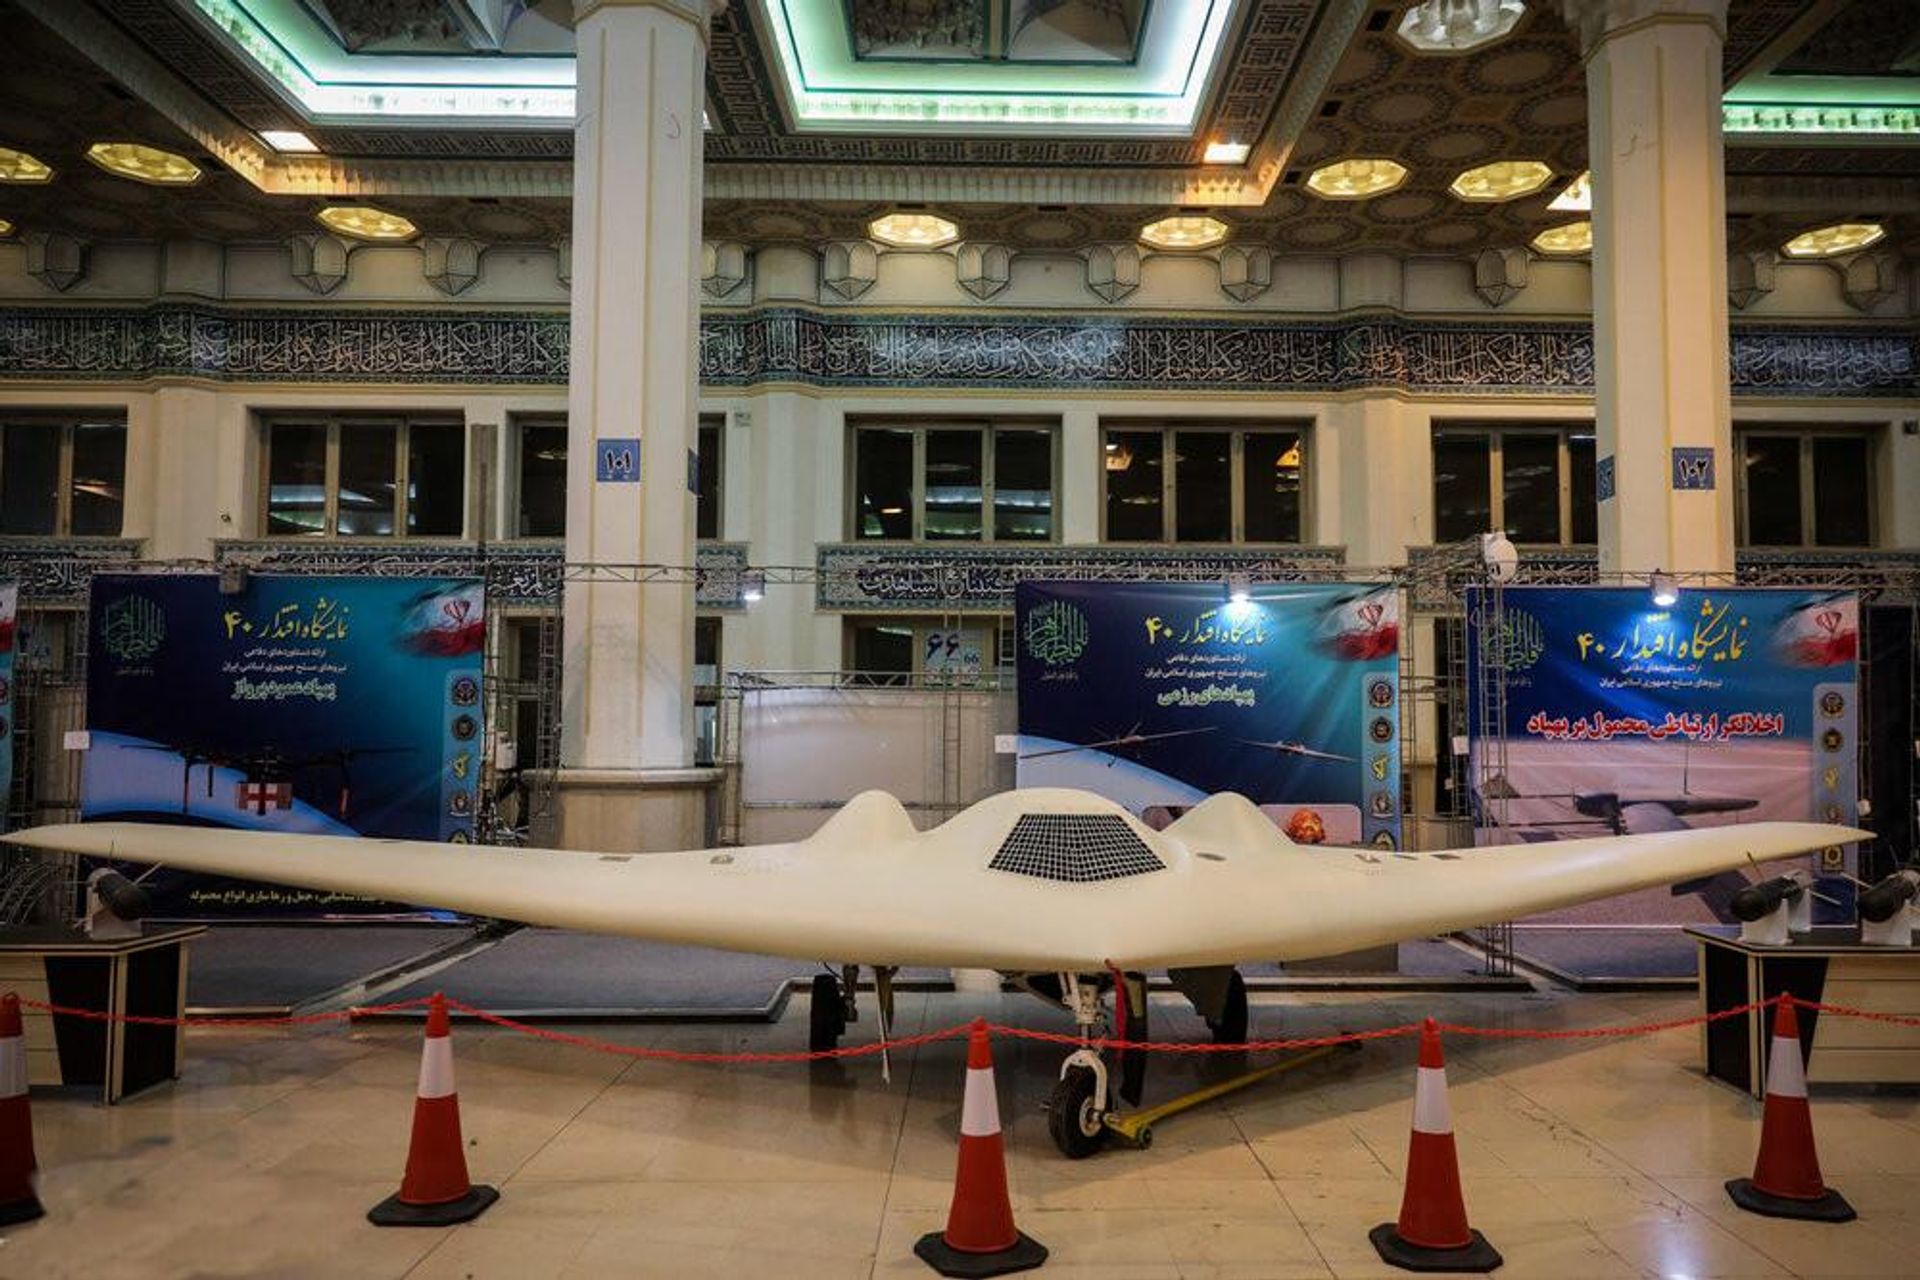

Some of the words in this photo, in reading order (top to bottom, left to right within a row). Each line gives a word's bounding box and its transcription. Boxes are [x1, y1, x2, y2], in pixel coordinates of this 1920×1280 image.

[605, 449, 632, 473] ۱۰۱
[1678, 457, 1708, 481] ۱۰۲
[224, 611, 254, 640] ۴۰
[257, 604, 301, 640] اقتدار
[300, 597, 349, 640] نمایشگاه
[1145, 615, 1174, 645] ۴۰
[1178, 609, 1221, 645] اقتدار
[1677, 598, 1750, 662] نمایشگاه
[1576, 632, 1606, 662] ۴۰
[1610, 612, 1675, 662] اقتدار
[1527, 712, 1570, 740] پهپاد
[1590, 711, 1649, 741] محمول
[1649, 712, 1718, 741] ارتباطی
[1718, 713, 1784, 741] اخلالگر
